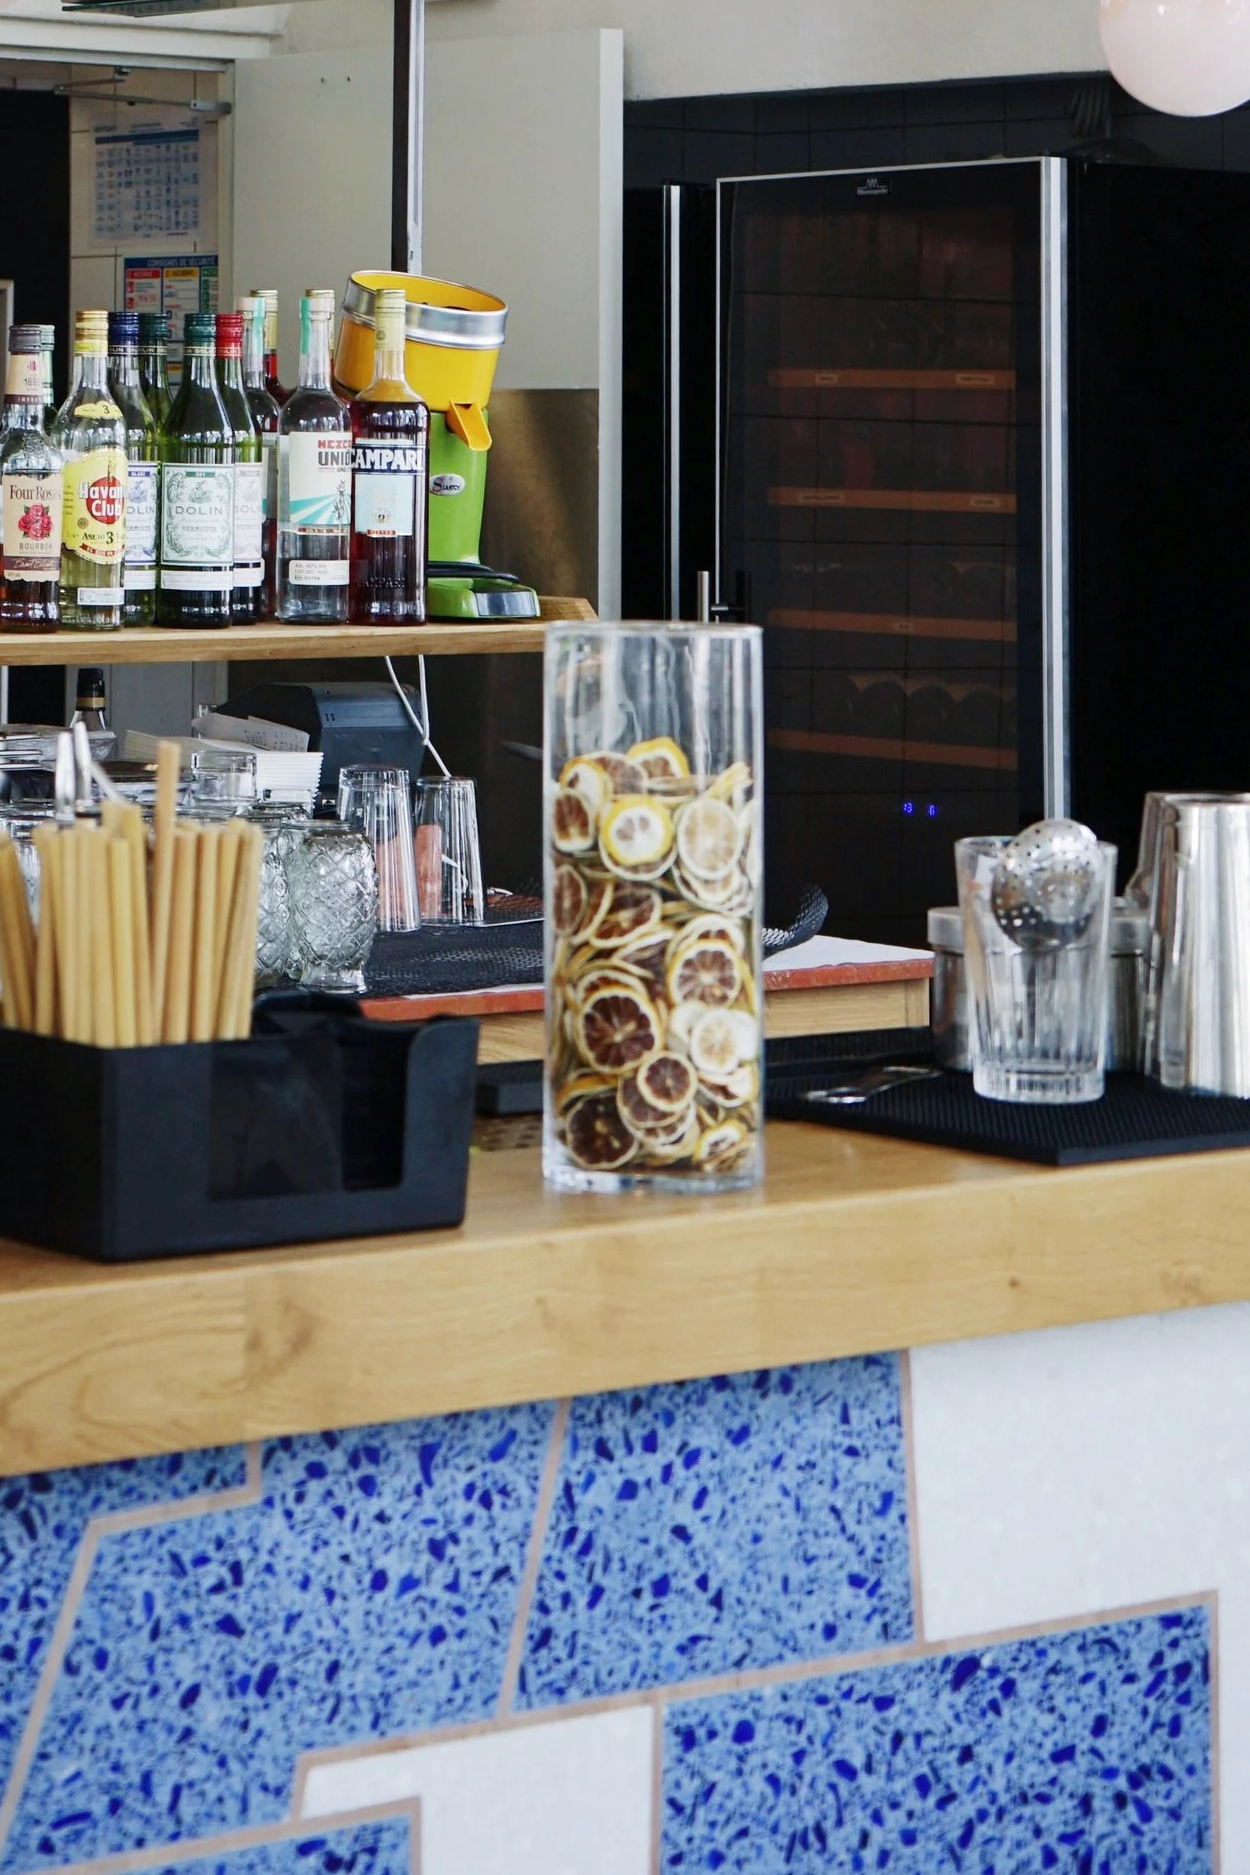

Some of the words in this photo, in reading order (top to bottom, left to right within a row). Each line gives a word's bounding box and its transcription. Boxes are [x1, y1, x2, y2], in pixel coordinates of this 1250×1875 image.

[101, 404, 110, 415] 3
[351, 448, 425, 471] CAMPARI
[9, 484, 36, 500] Four
[91, 498, 122, 518] Club
[175, 506, 223, 516] DOLIN
[105, 530, 114, 545] 3
[19, 541, 53, 551] BOURBON
